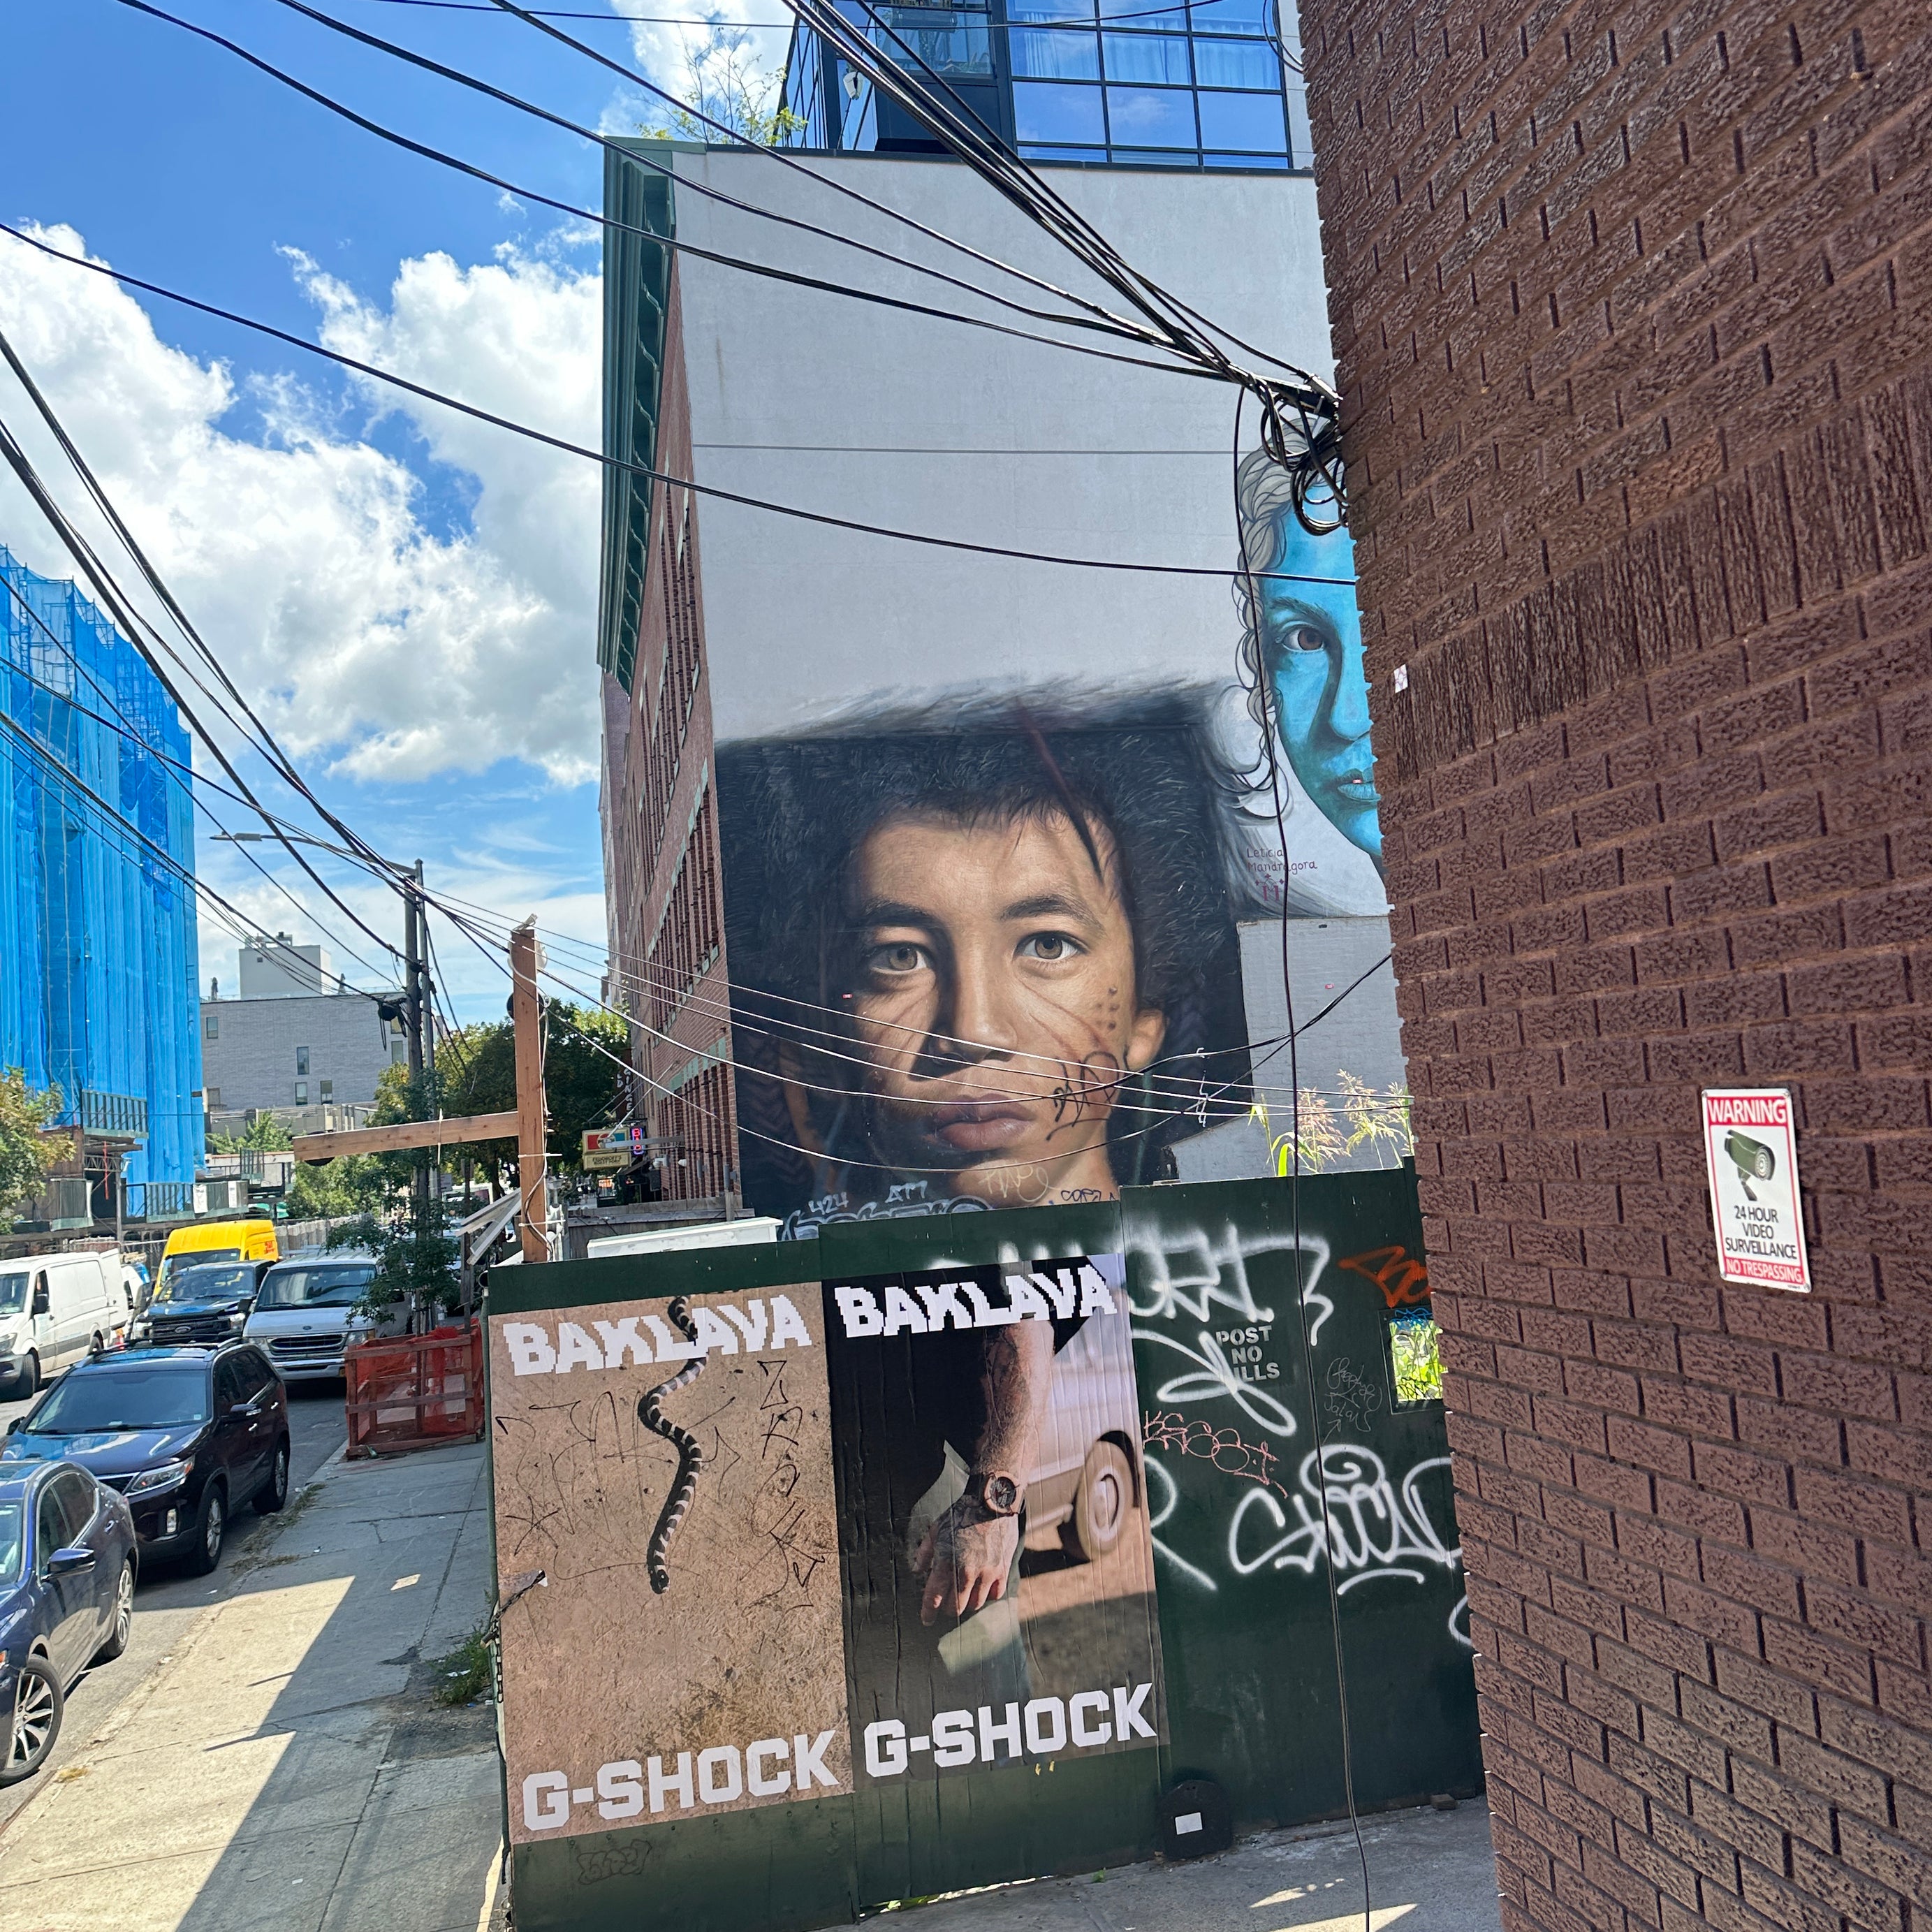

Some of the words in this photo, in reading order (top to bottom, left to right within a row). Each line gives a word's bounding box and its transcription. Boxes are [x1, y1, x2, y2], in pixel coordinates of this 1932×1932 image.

[1708, 1099, 1787, 1123] WARNING
[1734, 1205, 1747, 1220] 24
[1748, 1206, 1779, 1223] HOUR
[1743, 1224, 1774, 1239] VIDEO
[1725, 1236, 1798, 1260] SURVEILLANCE
[1726, 1259, 1741, 1275] NO
[1742, 1261, 1803, 1283] TRESPASSING
[1215, 1325, 1272, 1347] POST
[1231, 1345, 1263, 1364] NO
[1234, 1362, 1280, 1382] ILLS
[863, 1682, 1157, 1778] G-SHOCK
[522, 1730, 840, 1831] G-SHOCK
